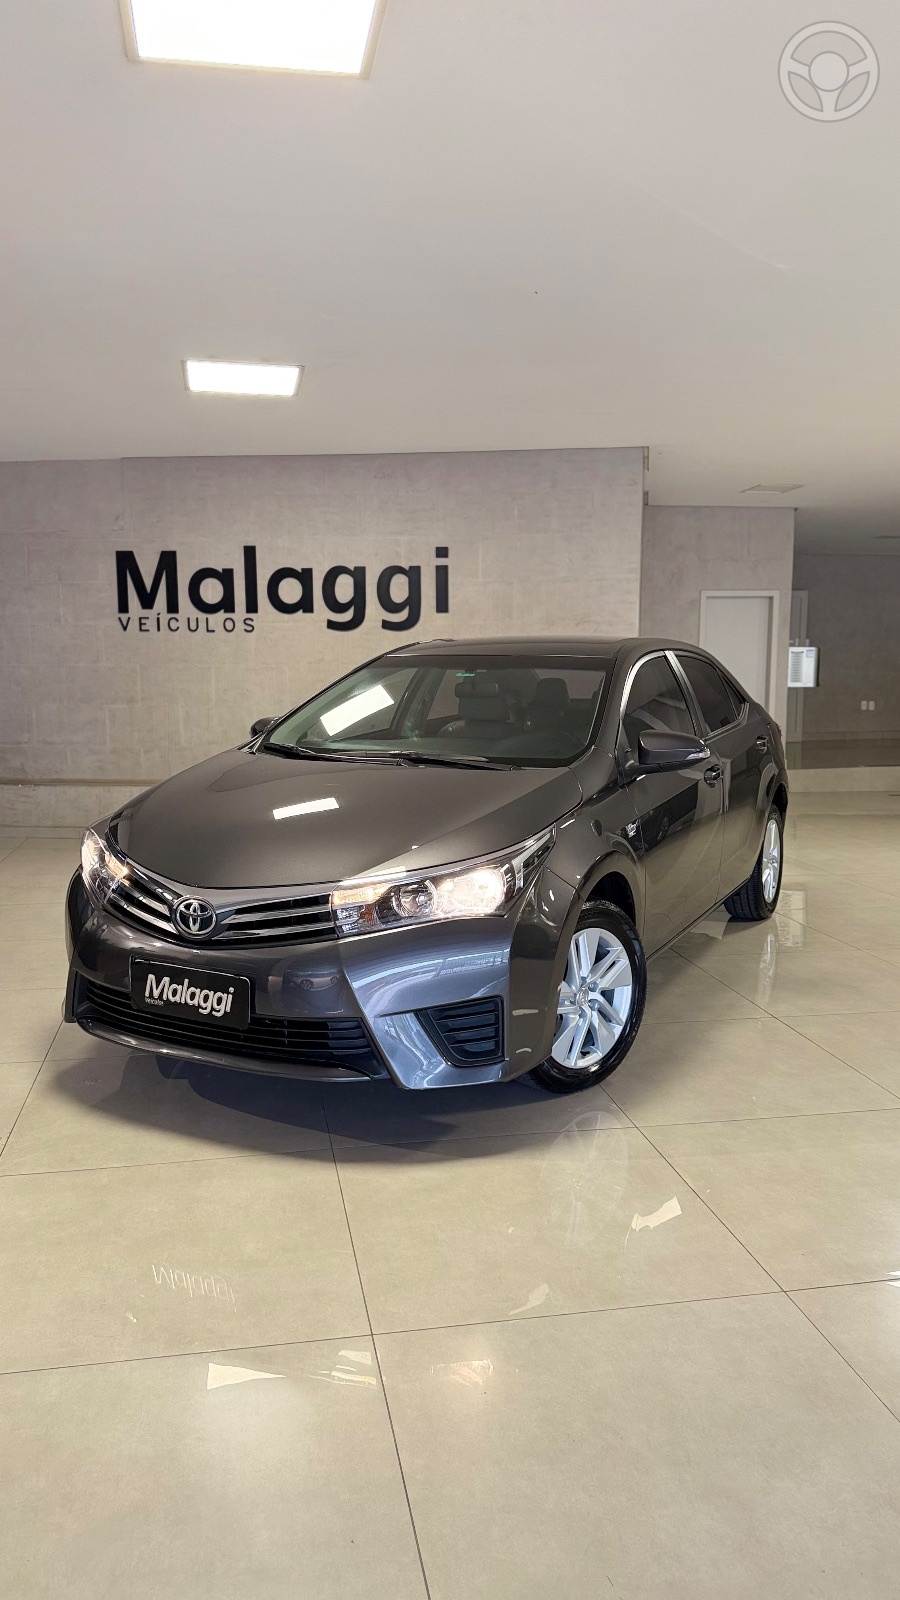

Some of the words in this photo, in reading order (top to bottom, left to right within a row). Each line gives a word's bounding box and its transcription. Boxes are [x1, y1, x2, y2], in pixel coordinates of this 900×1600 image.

[115, 545, 449, 632] Malaggi
[118, 613, 255, 633] VEÍCULOS
[145, 973, 235, 1017] Malaggi
